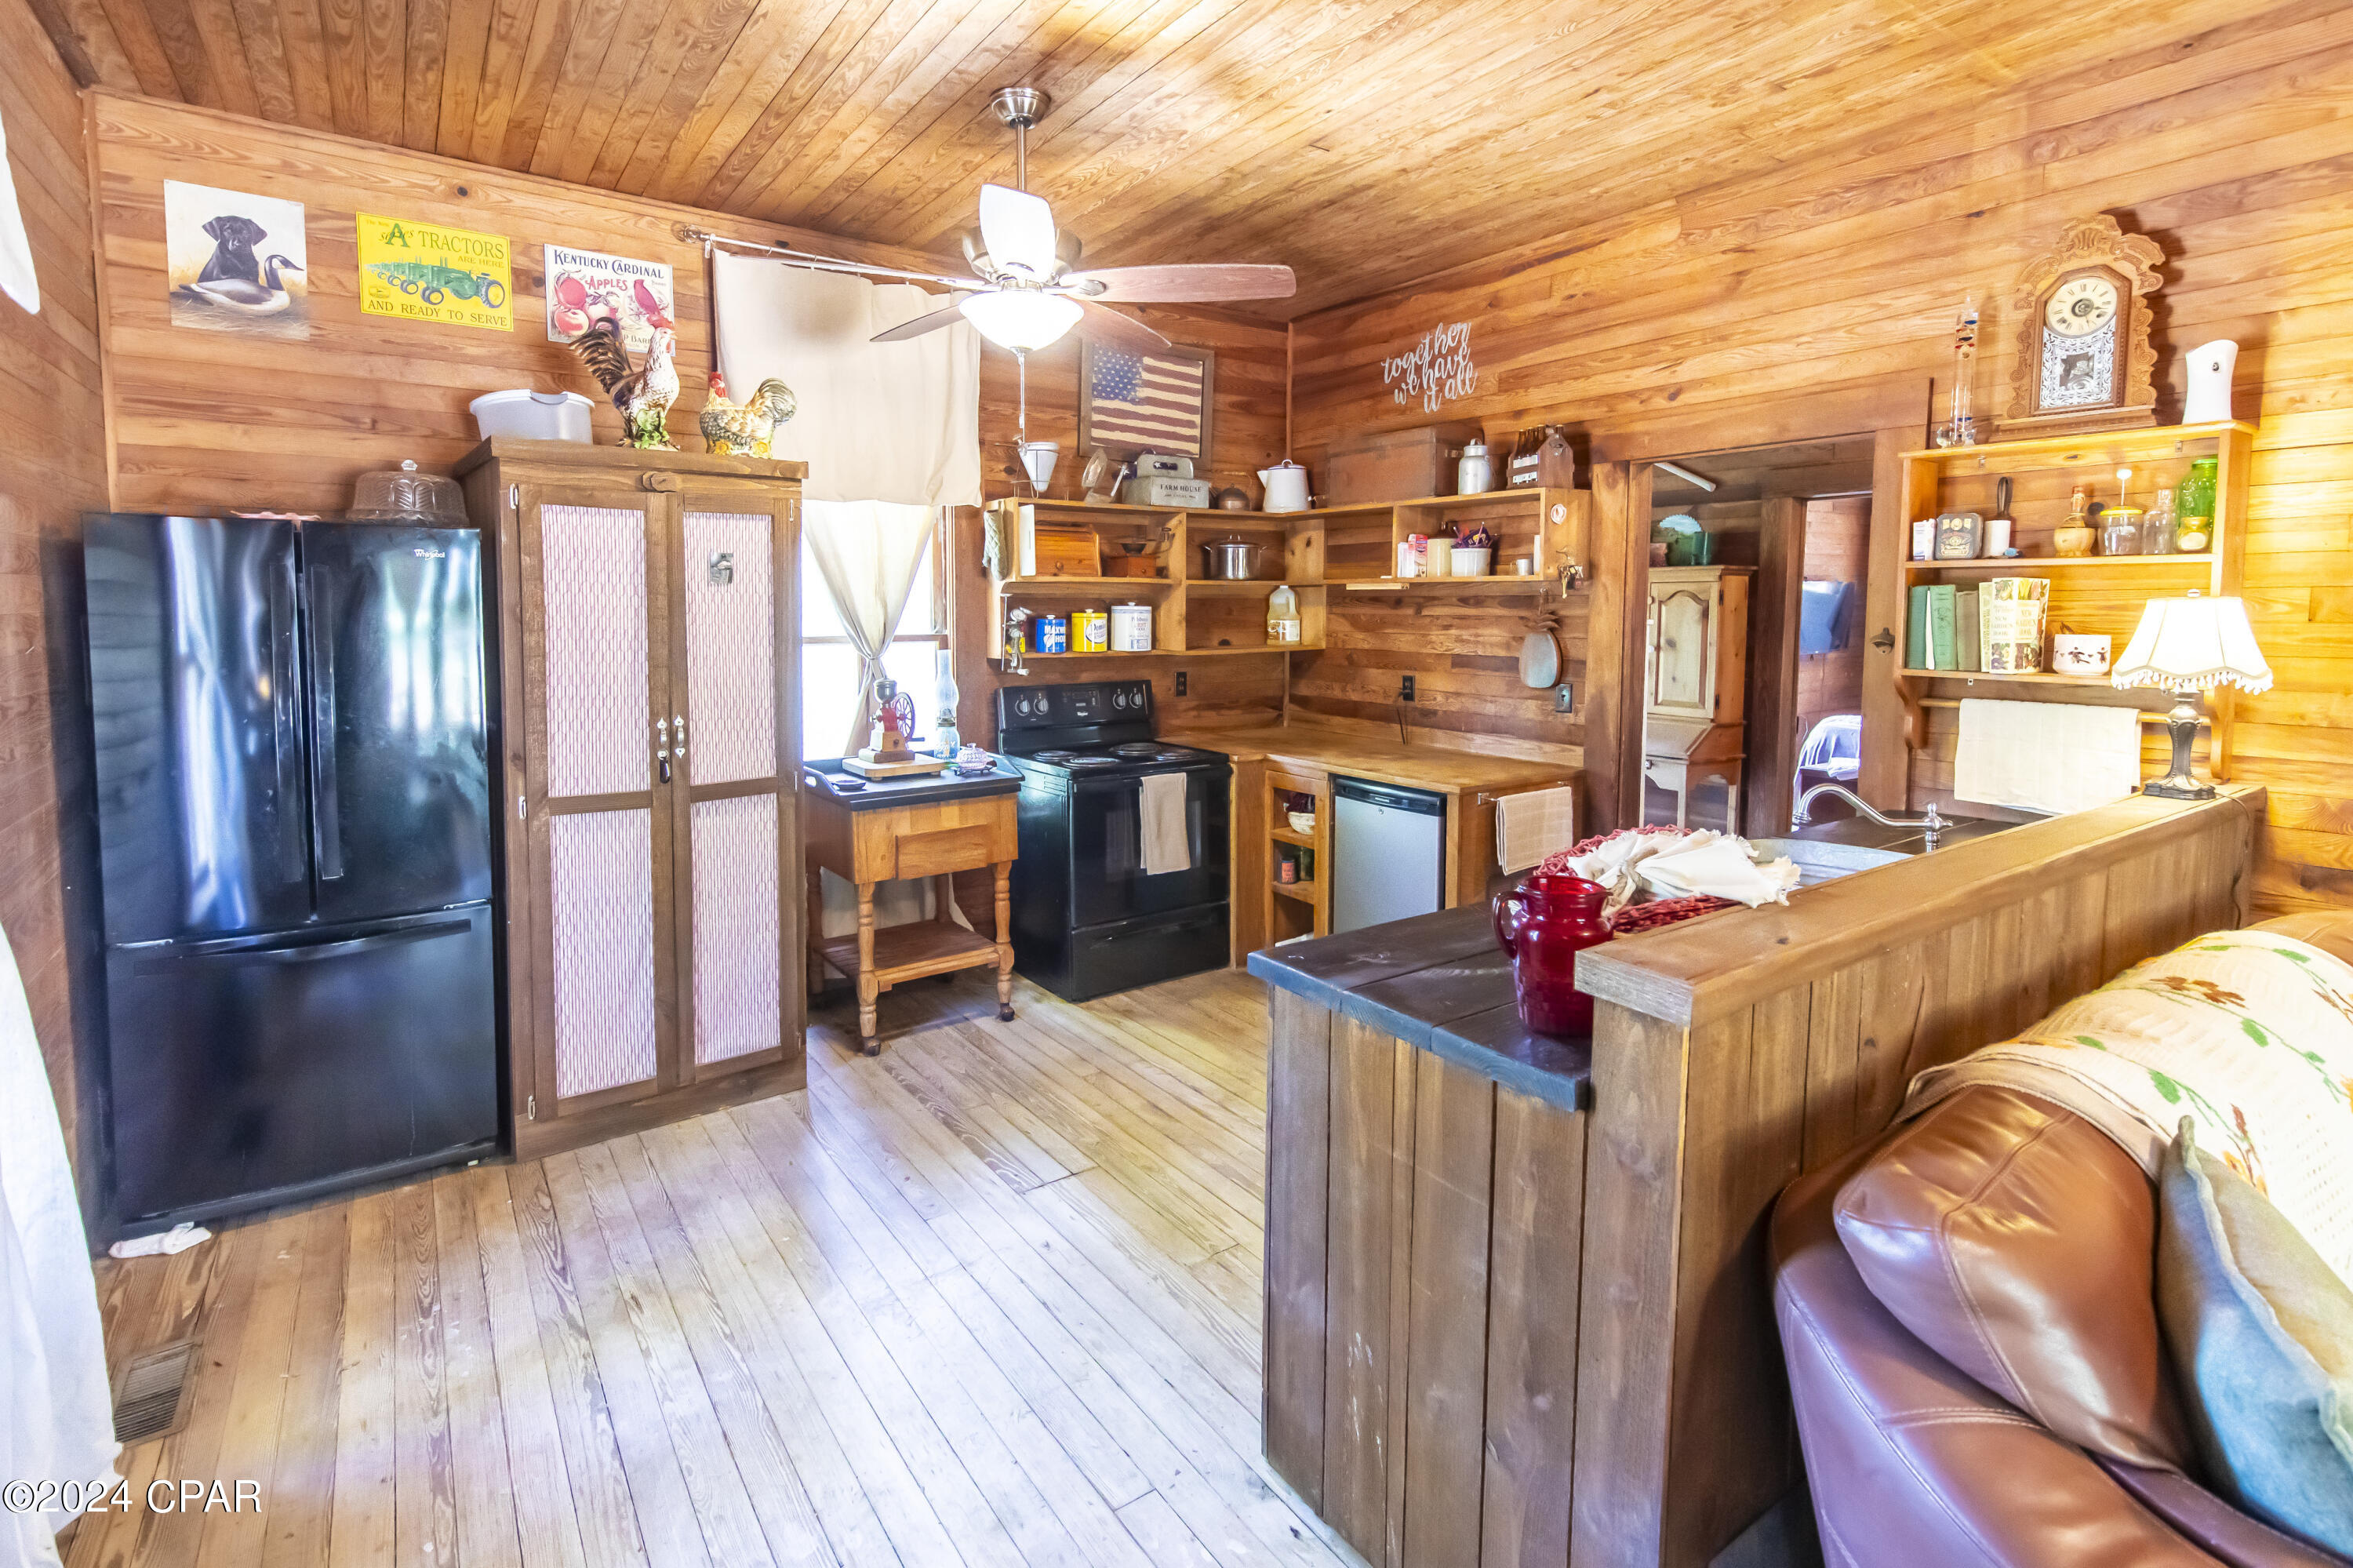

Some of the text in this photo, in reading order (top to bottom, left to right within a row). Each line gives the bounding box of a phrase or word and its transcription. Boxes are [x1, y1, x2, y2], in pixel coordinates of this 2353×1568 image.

[384, 223, 410, 248] A
[418, 230, 504, 260] TRACTORS
[457, 255, 504, 269] ARE HERE
[554, 249, 664, 279] KENTUCKY CARDINAL
[585, 275, 628, 292] APPLES
[368, 300, 507, 327] AND READY TO SERVE
[1380, 322, 1472, 384] together
[1394, 344, 1471, 405] we have
[1424, 361, 1478, 413] it all
[413, 548, 446, 561] Whirlpool
